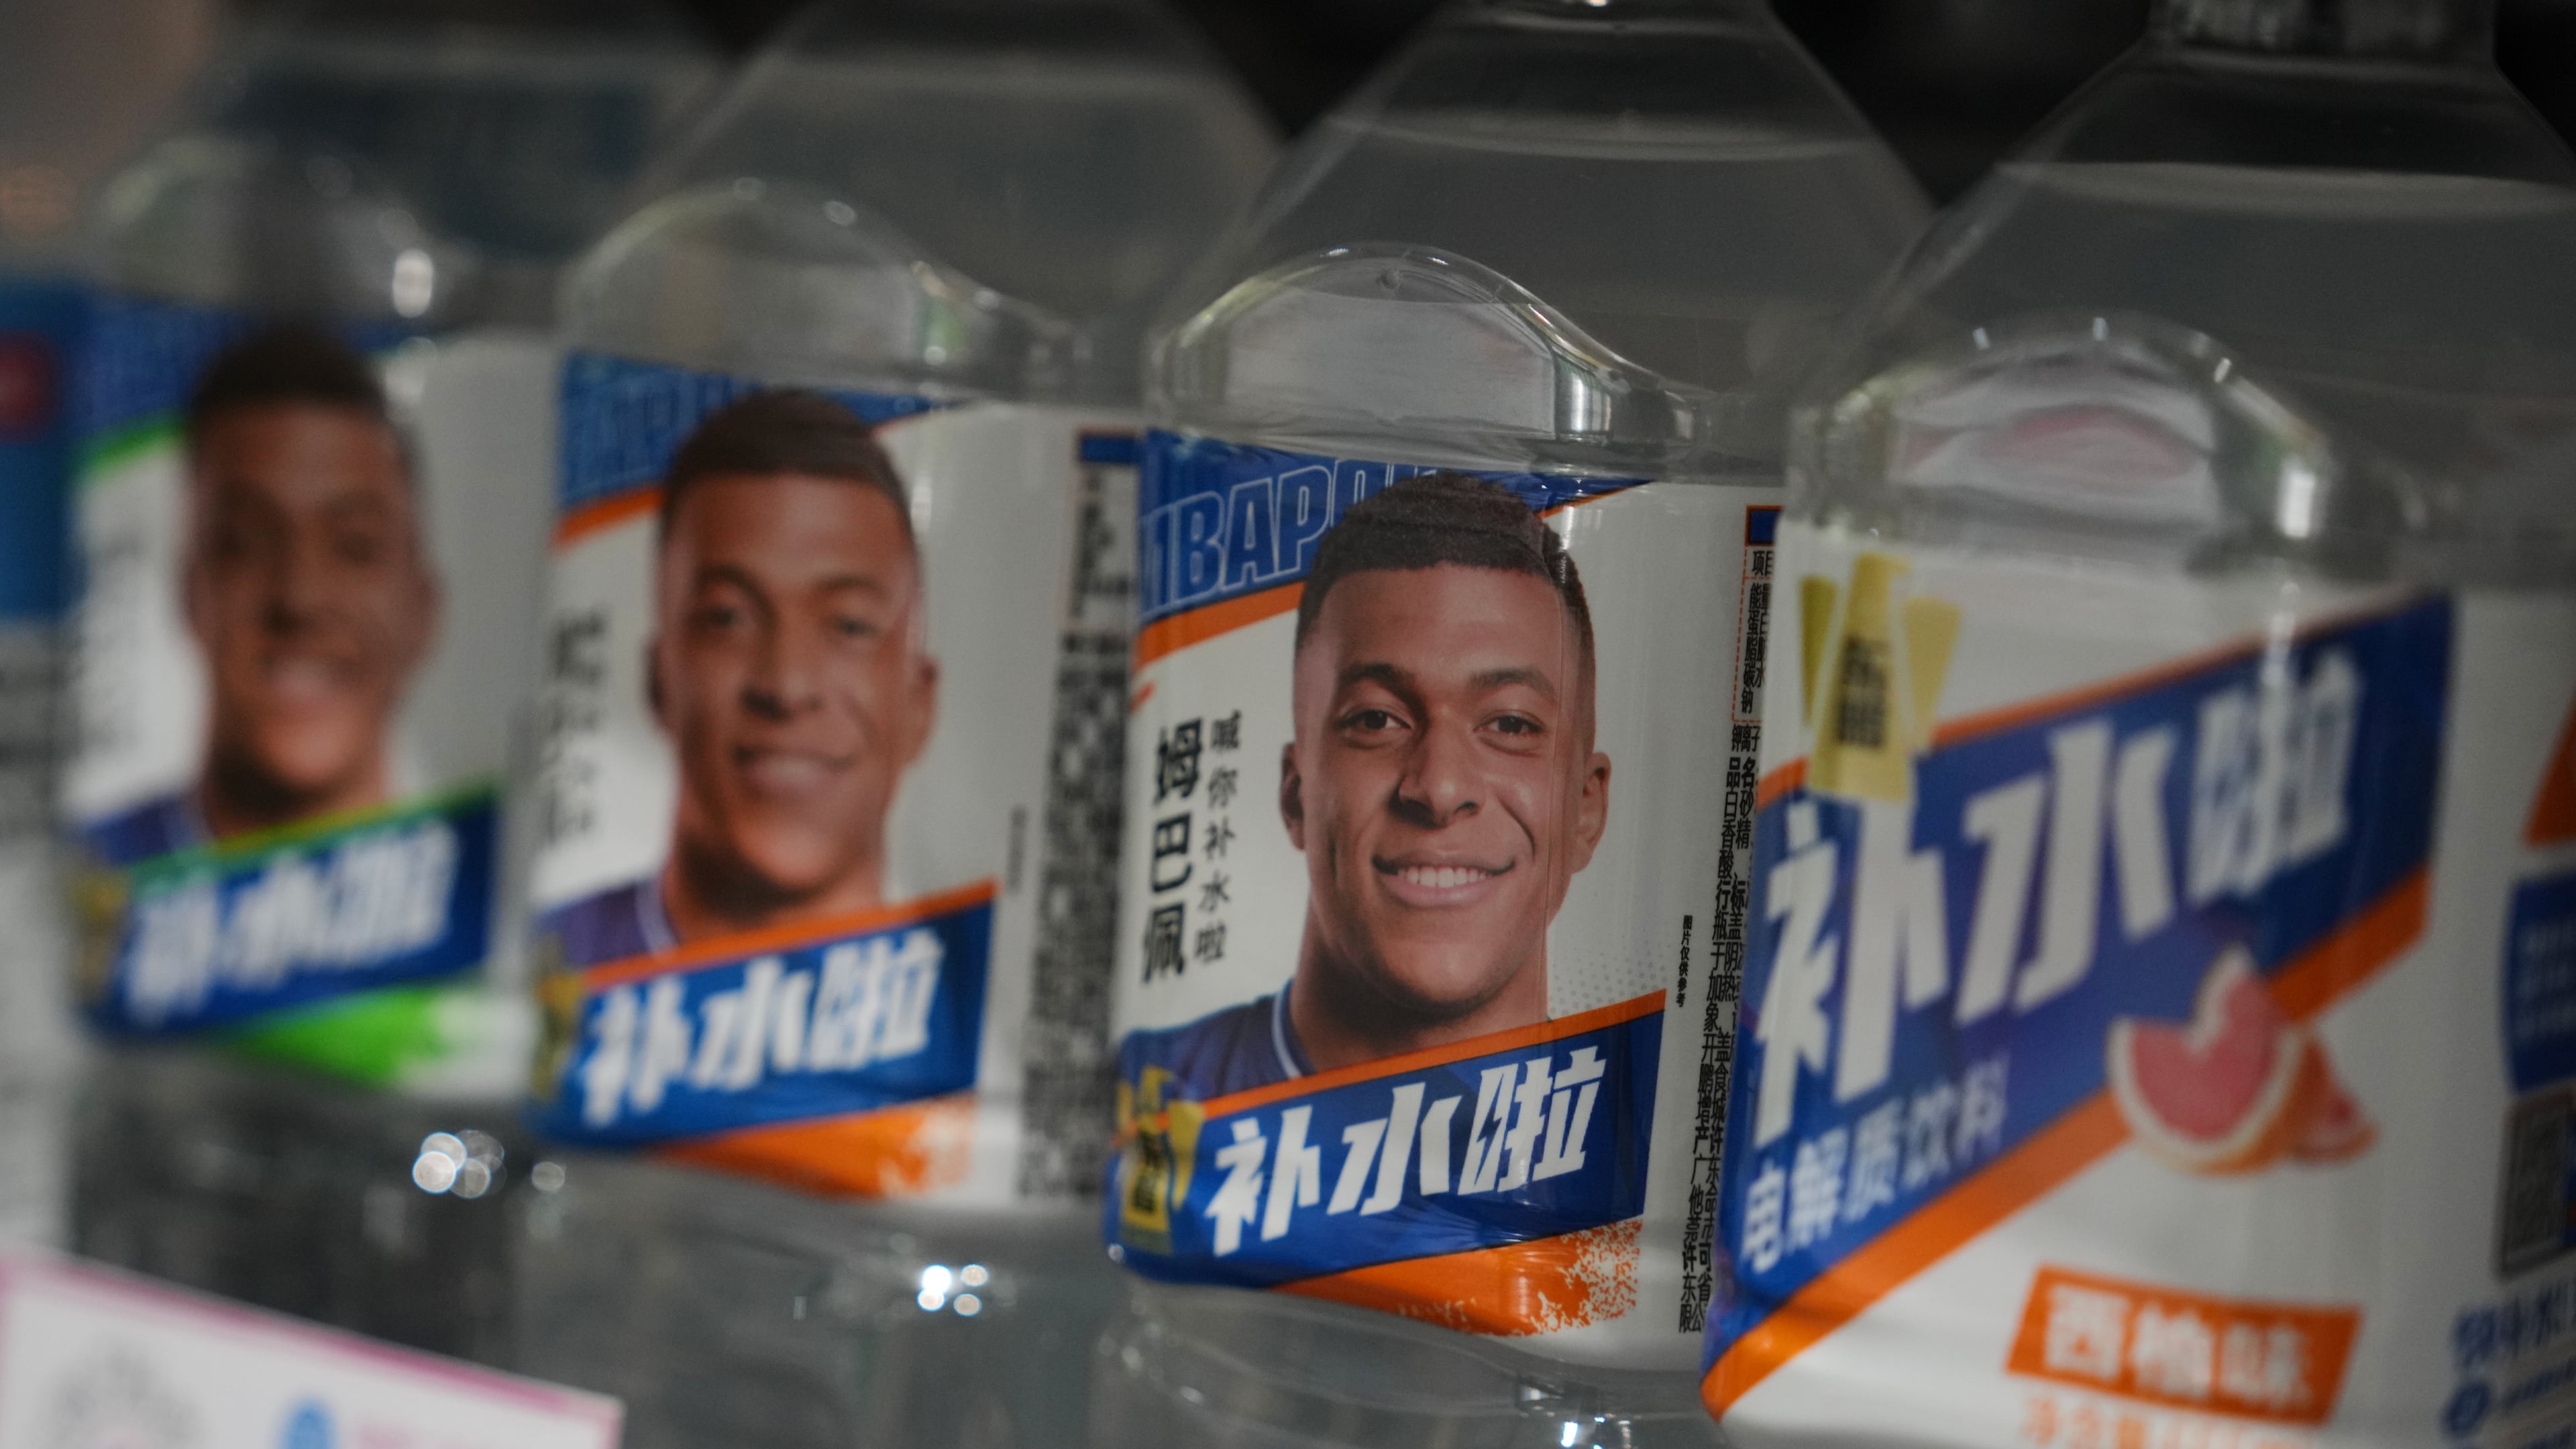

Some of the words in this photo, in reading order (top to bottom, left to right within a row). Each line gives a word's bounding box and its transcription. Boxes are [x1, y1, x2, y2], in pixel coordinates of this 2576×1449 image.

[1139, 459, 1438, 619] BAP
[1142, 717, 1203, 984] 姆巴佩
[1194, 710, 1242, 963] 喊你补水啦
[1724, 787, 1756, 819] 白砂
[1676, 914, 1693, 1008] 图片仅供参考
[1712, 910, 1746, 941] 瓶盖
[1753, 649, 2361, 1148] 补水啦
[581, 930, 942, 1126] 补水啦
[1697, 1062, 1732, 1095] 鹏食
[1205, 1046, 1607, 1256] 补水啦
[1678, 1303, 1707, 1334] 限公
